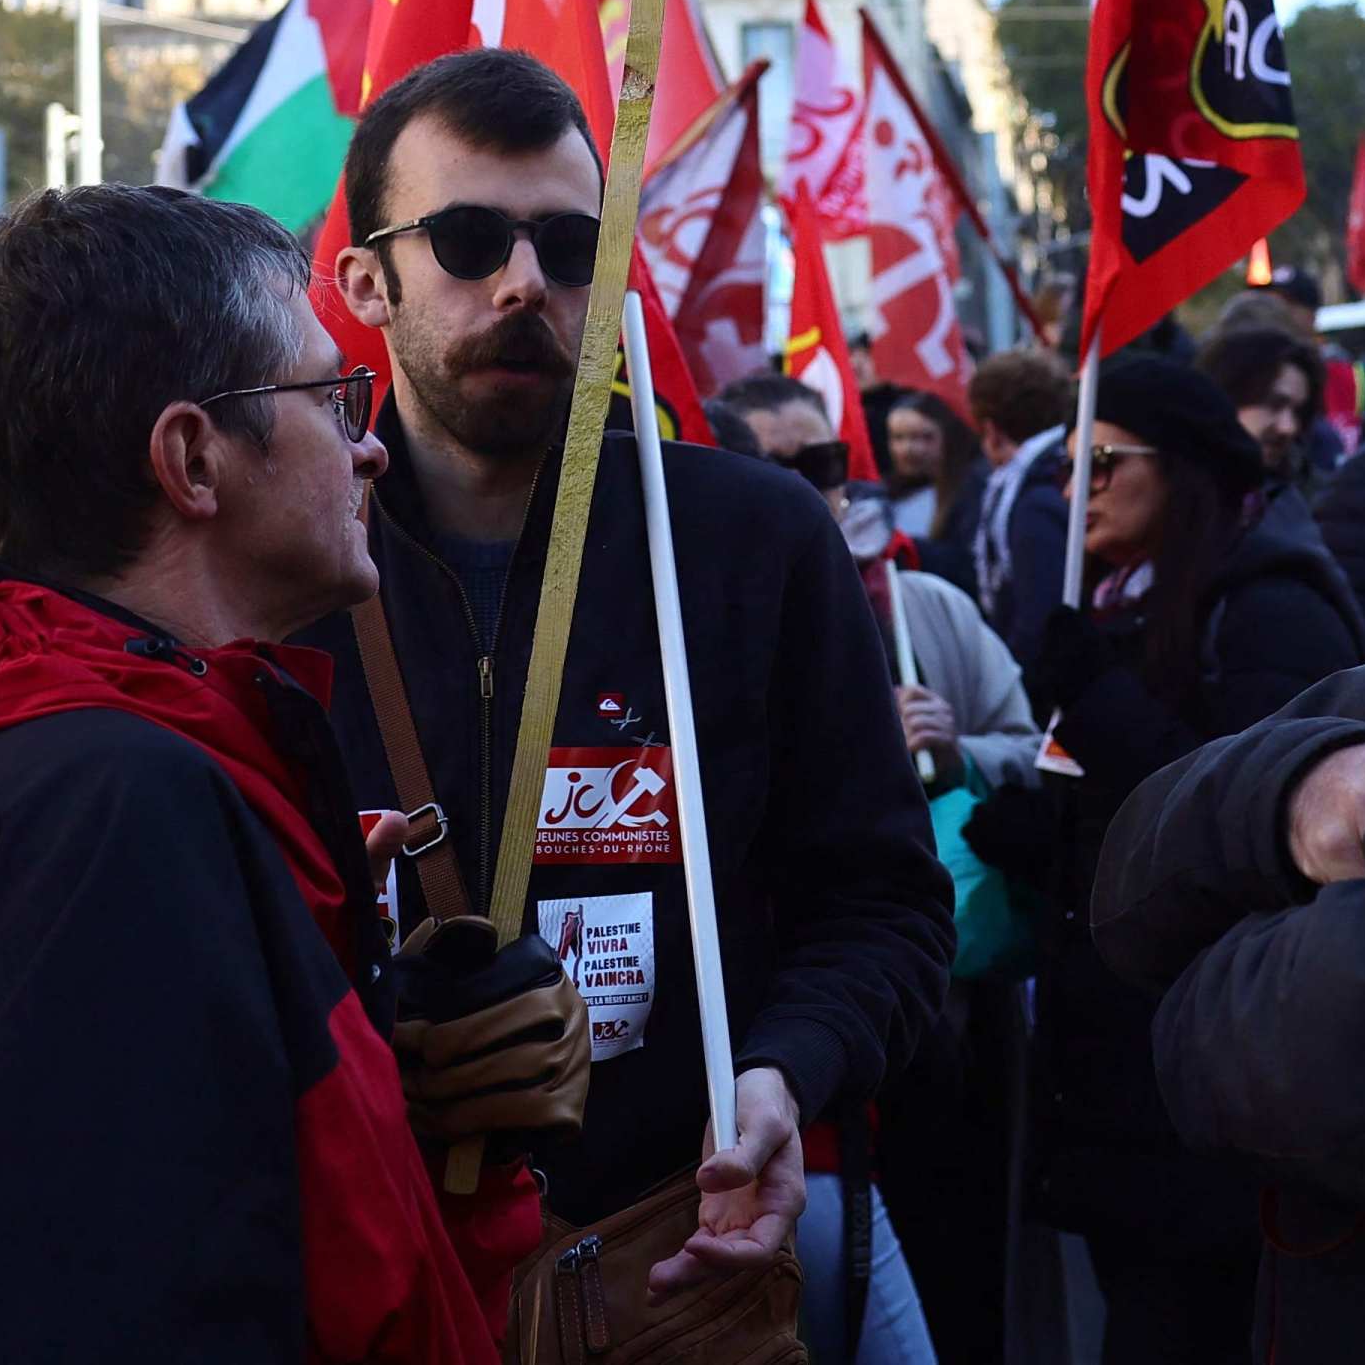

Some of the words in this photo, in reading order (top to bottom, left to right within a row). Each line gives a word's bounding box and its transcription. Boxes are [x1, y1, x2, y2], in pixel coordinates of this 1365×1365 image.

[536, 831, 579, 842] JEUNES
[583, 830, 670, 842] COMMUNISTES
[536, 843, 671, 853] BOUCHES-DU-RHÔNE
[586, 922, 641, 939] PALESTINE
[587, 937, 628, 955] VIVRA
[584, 955, 640, 972] PALESTINE
[584, 969, 645, 988] VAINCRA
